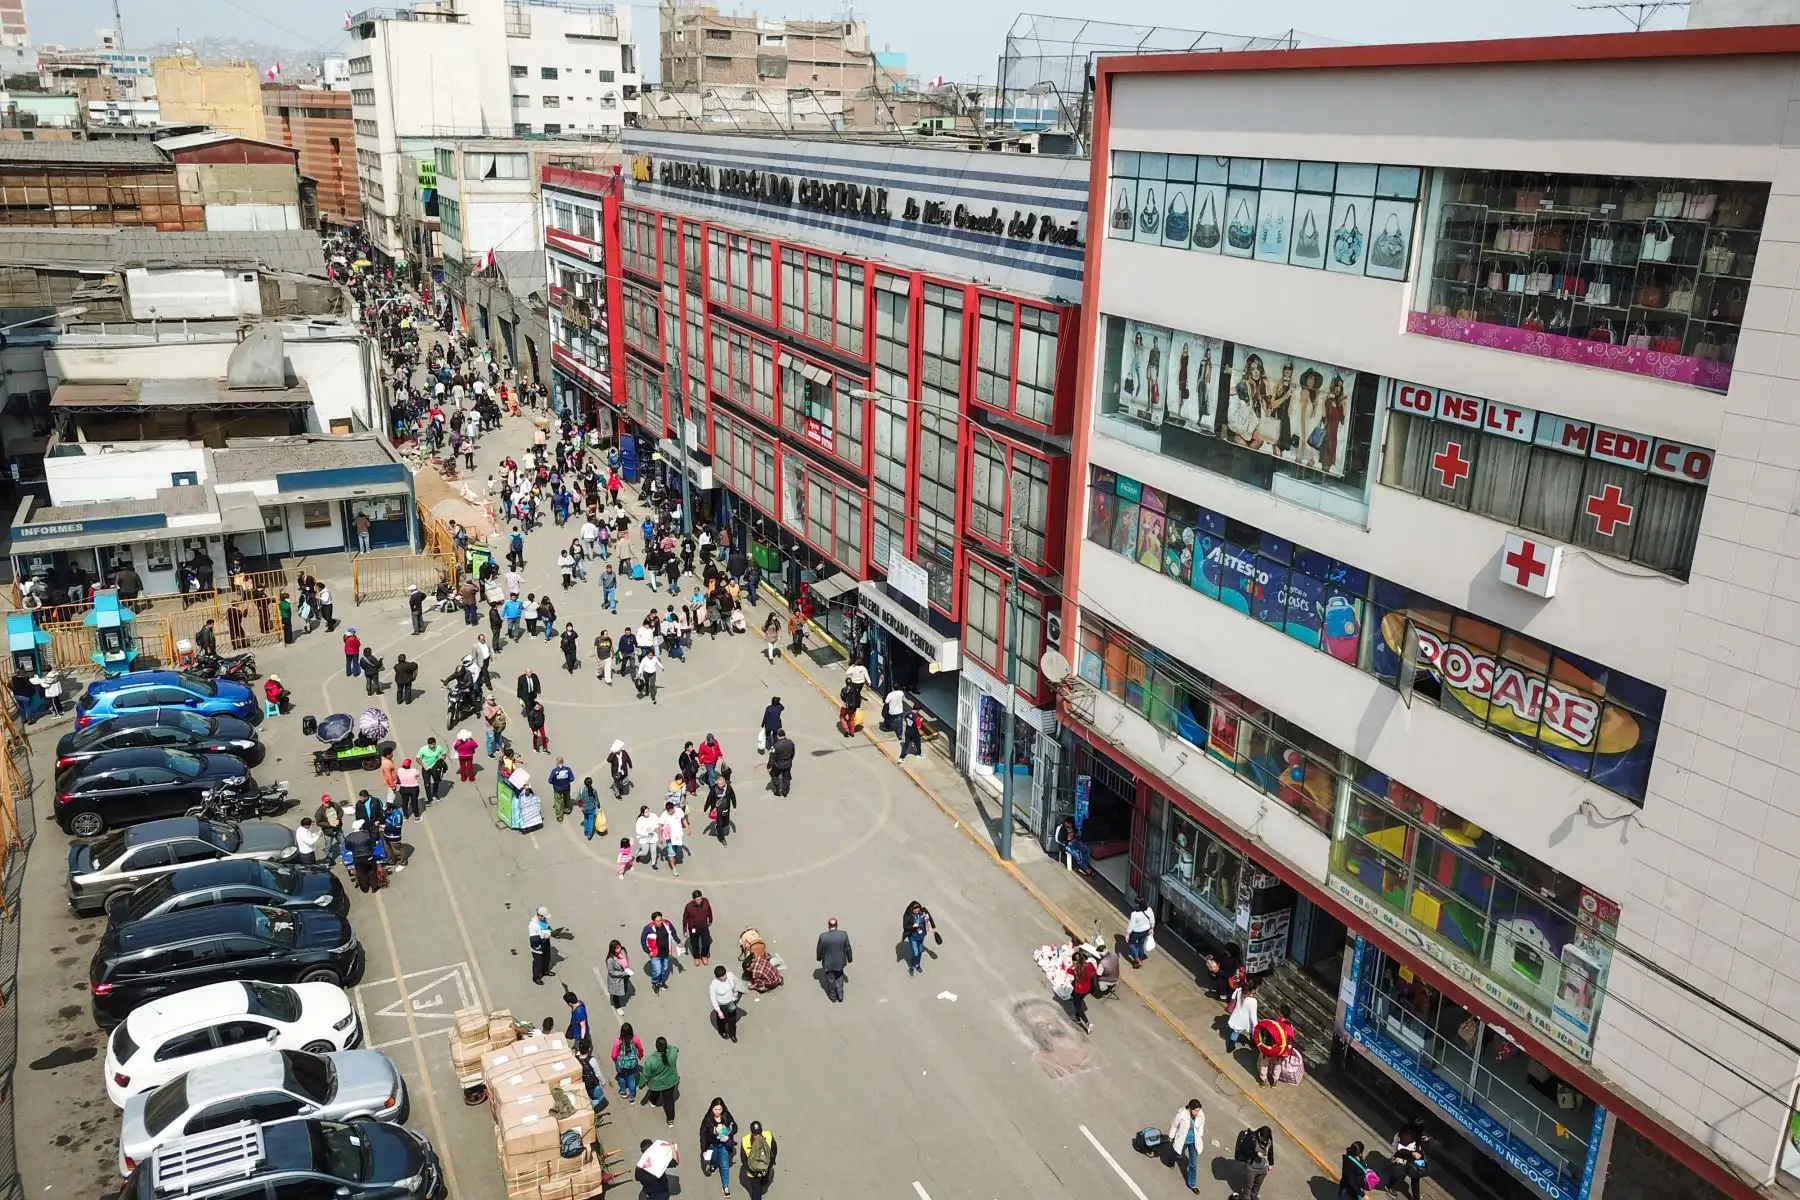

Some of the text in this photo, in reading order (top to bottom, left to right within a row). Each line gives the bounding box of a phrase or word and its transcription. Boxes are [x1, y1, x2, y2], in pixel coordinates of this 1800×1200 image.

[719, 168, 794, 202] MERCADO
[798, 177, 890, 219] CENTRAL
[1007, 210, 1037, 239] del
[20, 523, 84, 537] INFORMES
[1206, 546, 1269, 585] ARTESCO
[1277, 591, 1310, 612] Clases
[882, 609, 909, 638] MERCADO
[910, 628, 937, 660] CENTRAL
[1393, 1062, 1427, 1094] EXCLUSIVO
[1428, 1090, 1438, 1102] EN
[1438, 1099, 1472, 1130] CARTERAS
[1474, 1127, 1493, 1147] PARA
[1495, 1144, 1505, 1155] TU
[1506, 1152, 1560, 1199] NEGOCIO
